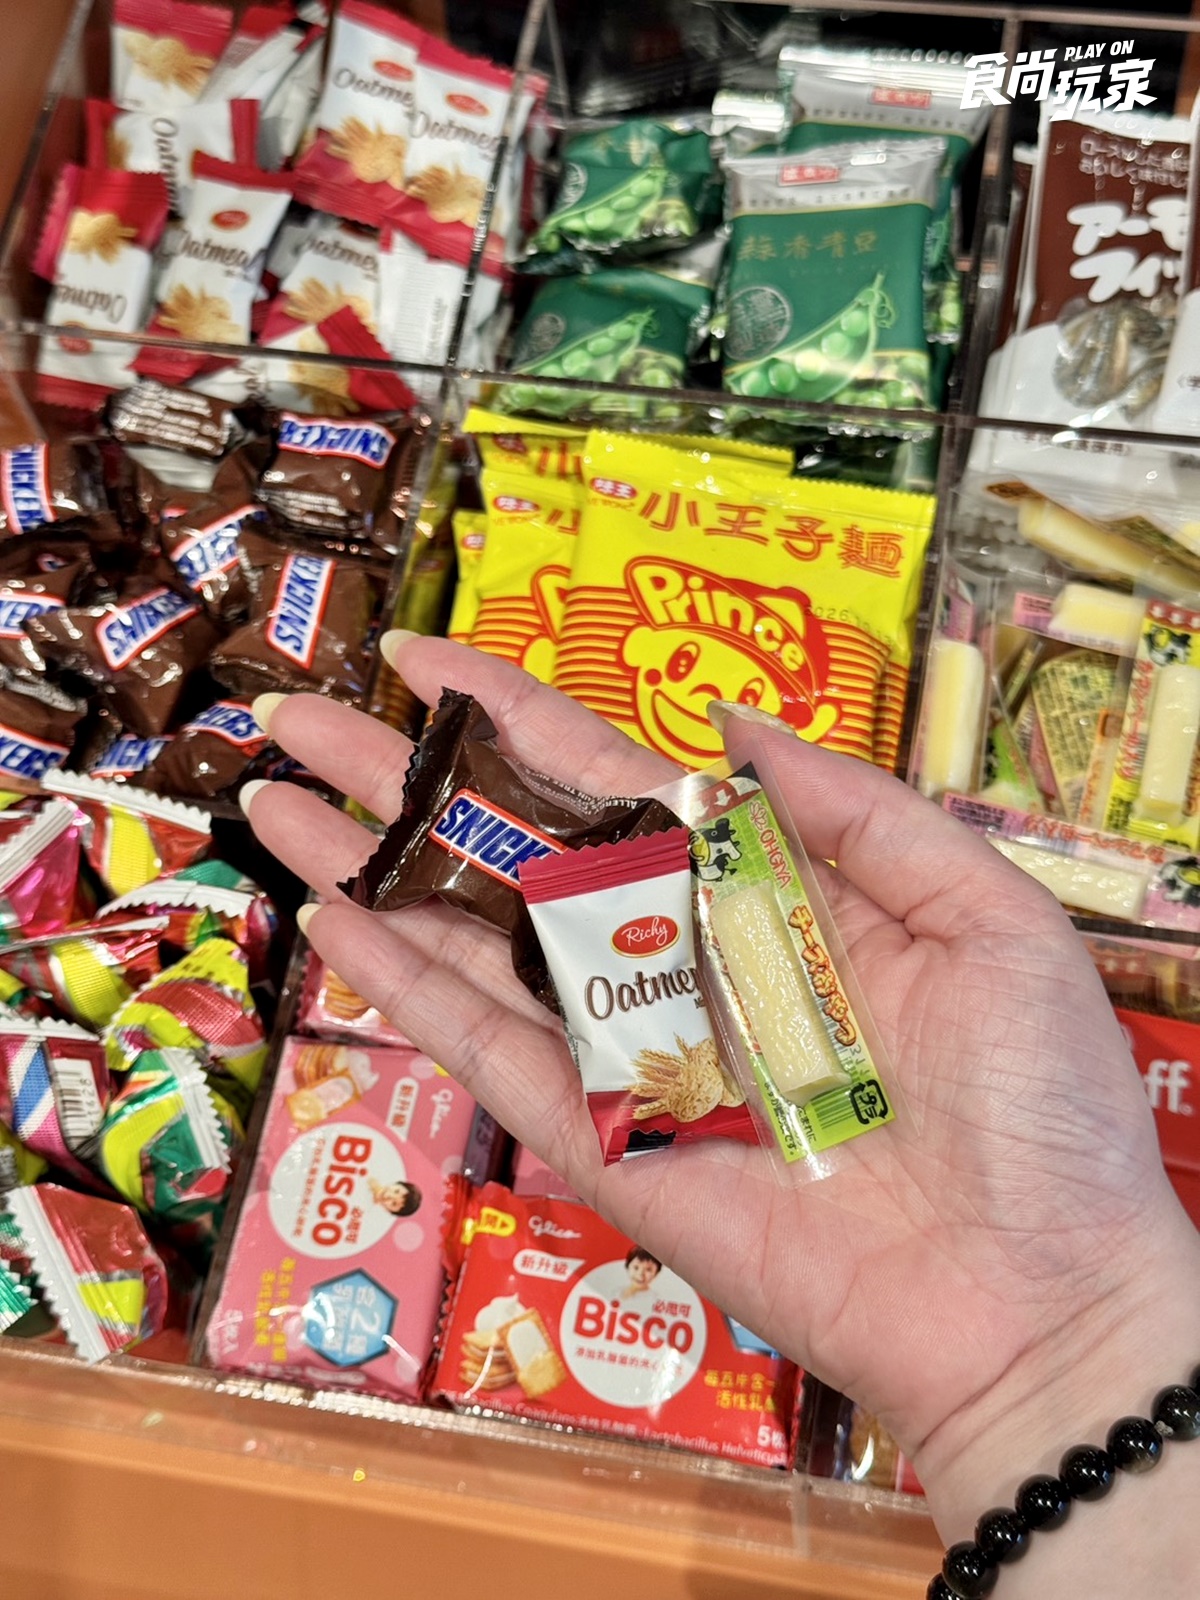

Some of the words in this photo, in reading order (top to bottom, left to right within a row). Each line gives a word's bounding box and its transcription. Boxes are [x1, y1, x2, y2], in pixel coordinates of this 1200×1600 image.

[638, 491, 905, 577] 小王子麵
[632, 564, 805, 672] Prince
[759, 828, 794, 890] OHGIYA
[621, 916, 669, 947] Richy
[311, 1135, 373, 1247] Bisco
[519, 1253, 570, 1276] 新升級
[573, 1295, 694, 1355] Bisco
